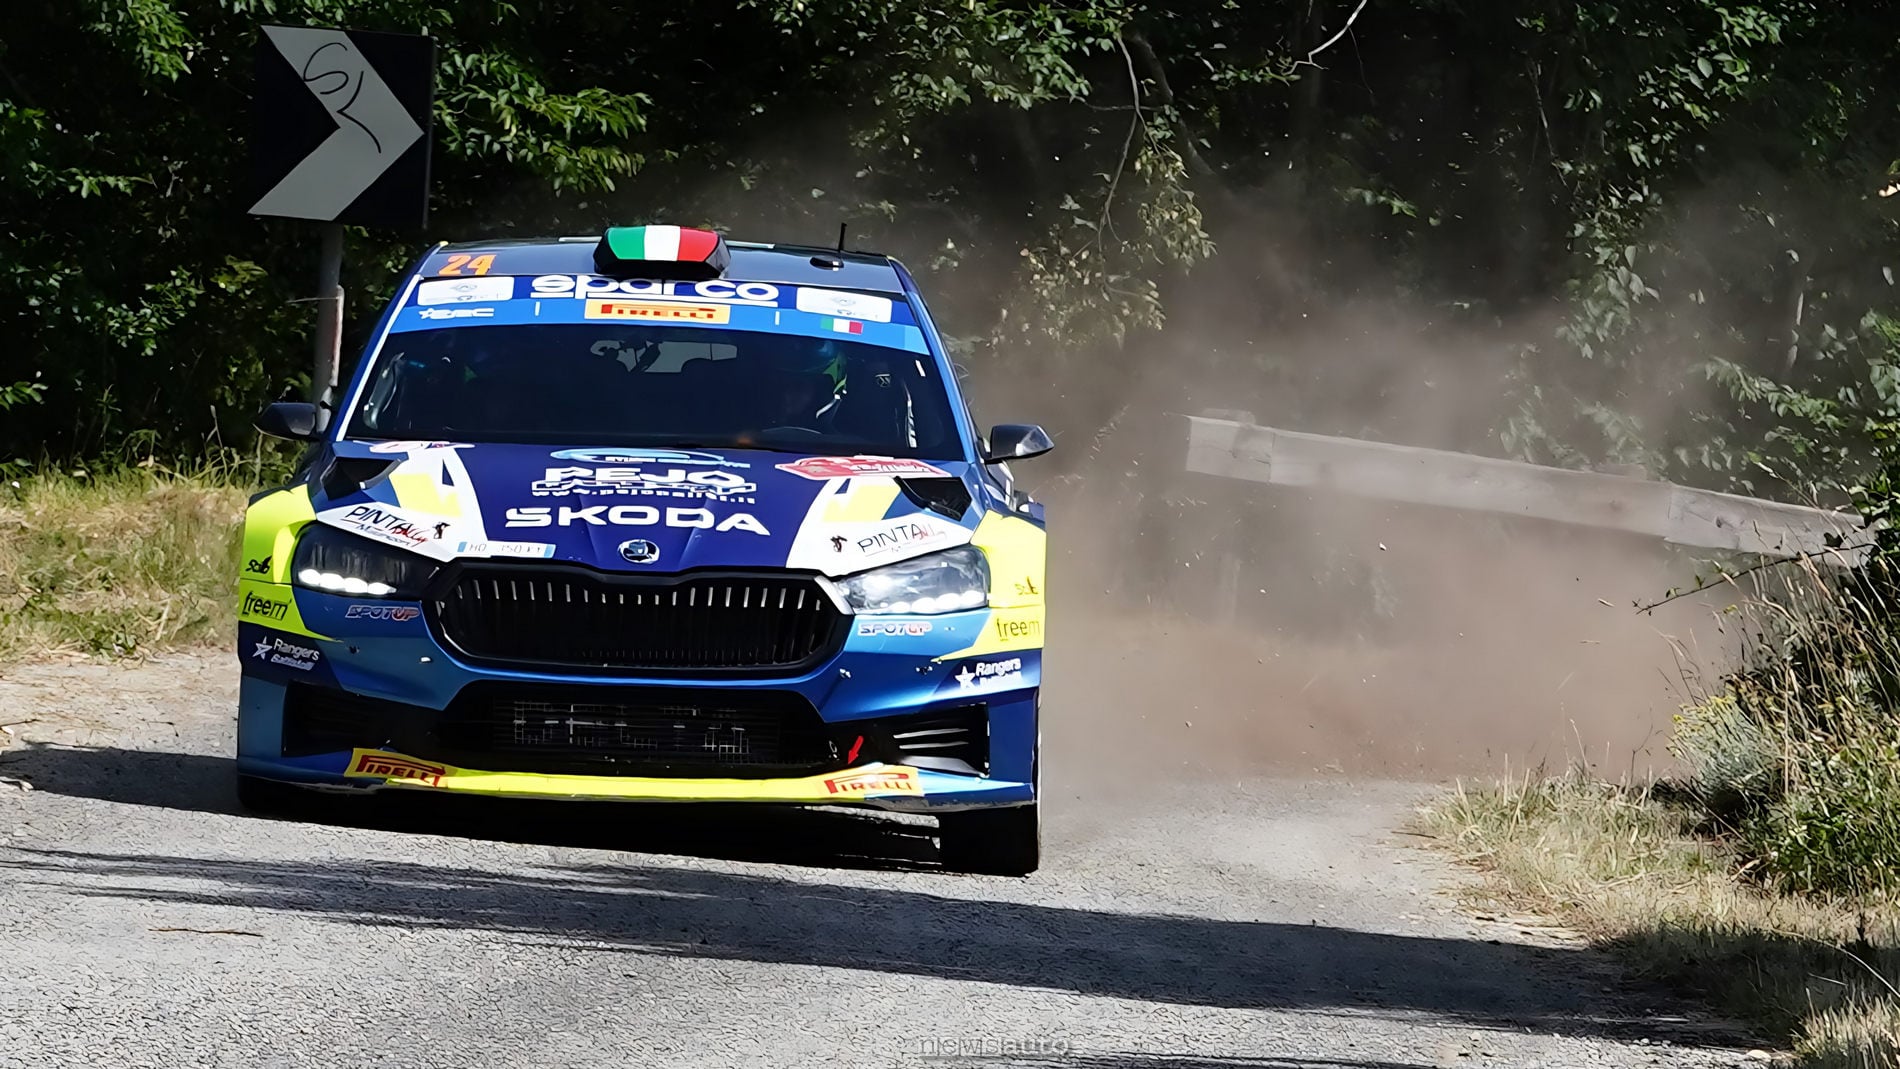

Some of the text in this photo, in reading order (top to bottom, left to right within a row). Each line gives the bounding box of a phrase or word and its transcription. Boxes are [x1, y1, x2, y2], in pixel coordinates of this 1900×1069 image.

[438, 255, 496, 275] 24
[531, 275, 779, 303] sparco
[601, 304, 716, 319] PIRELLI
[243, 591, 289, 621] freem
[345, 605, 420, 621] SPOTUP
[859, 622, 932, 636] SPOTUP
[273, 638, 320, 661] Rangers
[975, 658, 1022, 677] Rangers
[355, 754, 446, 788] PIRELLI
[824, 773, 912, 794] PIRELLI
